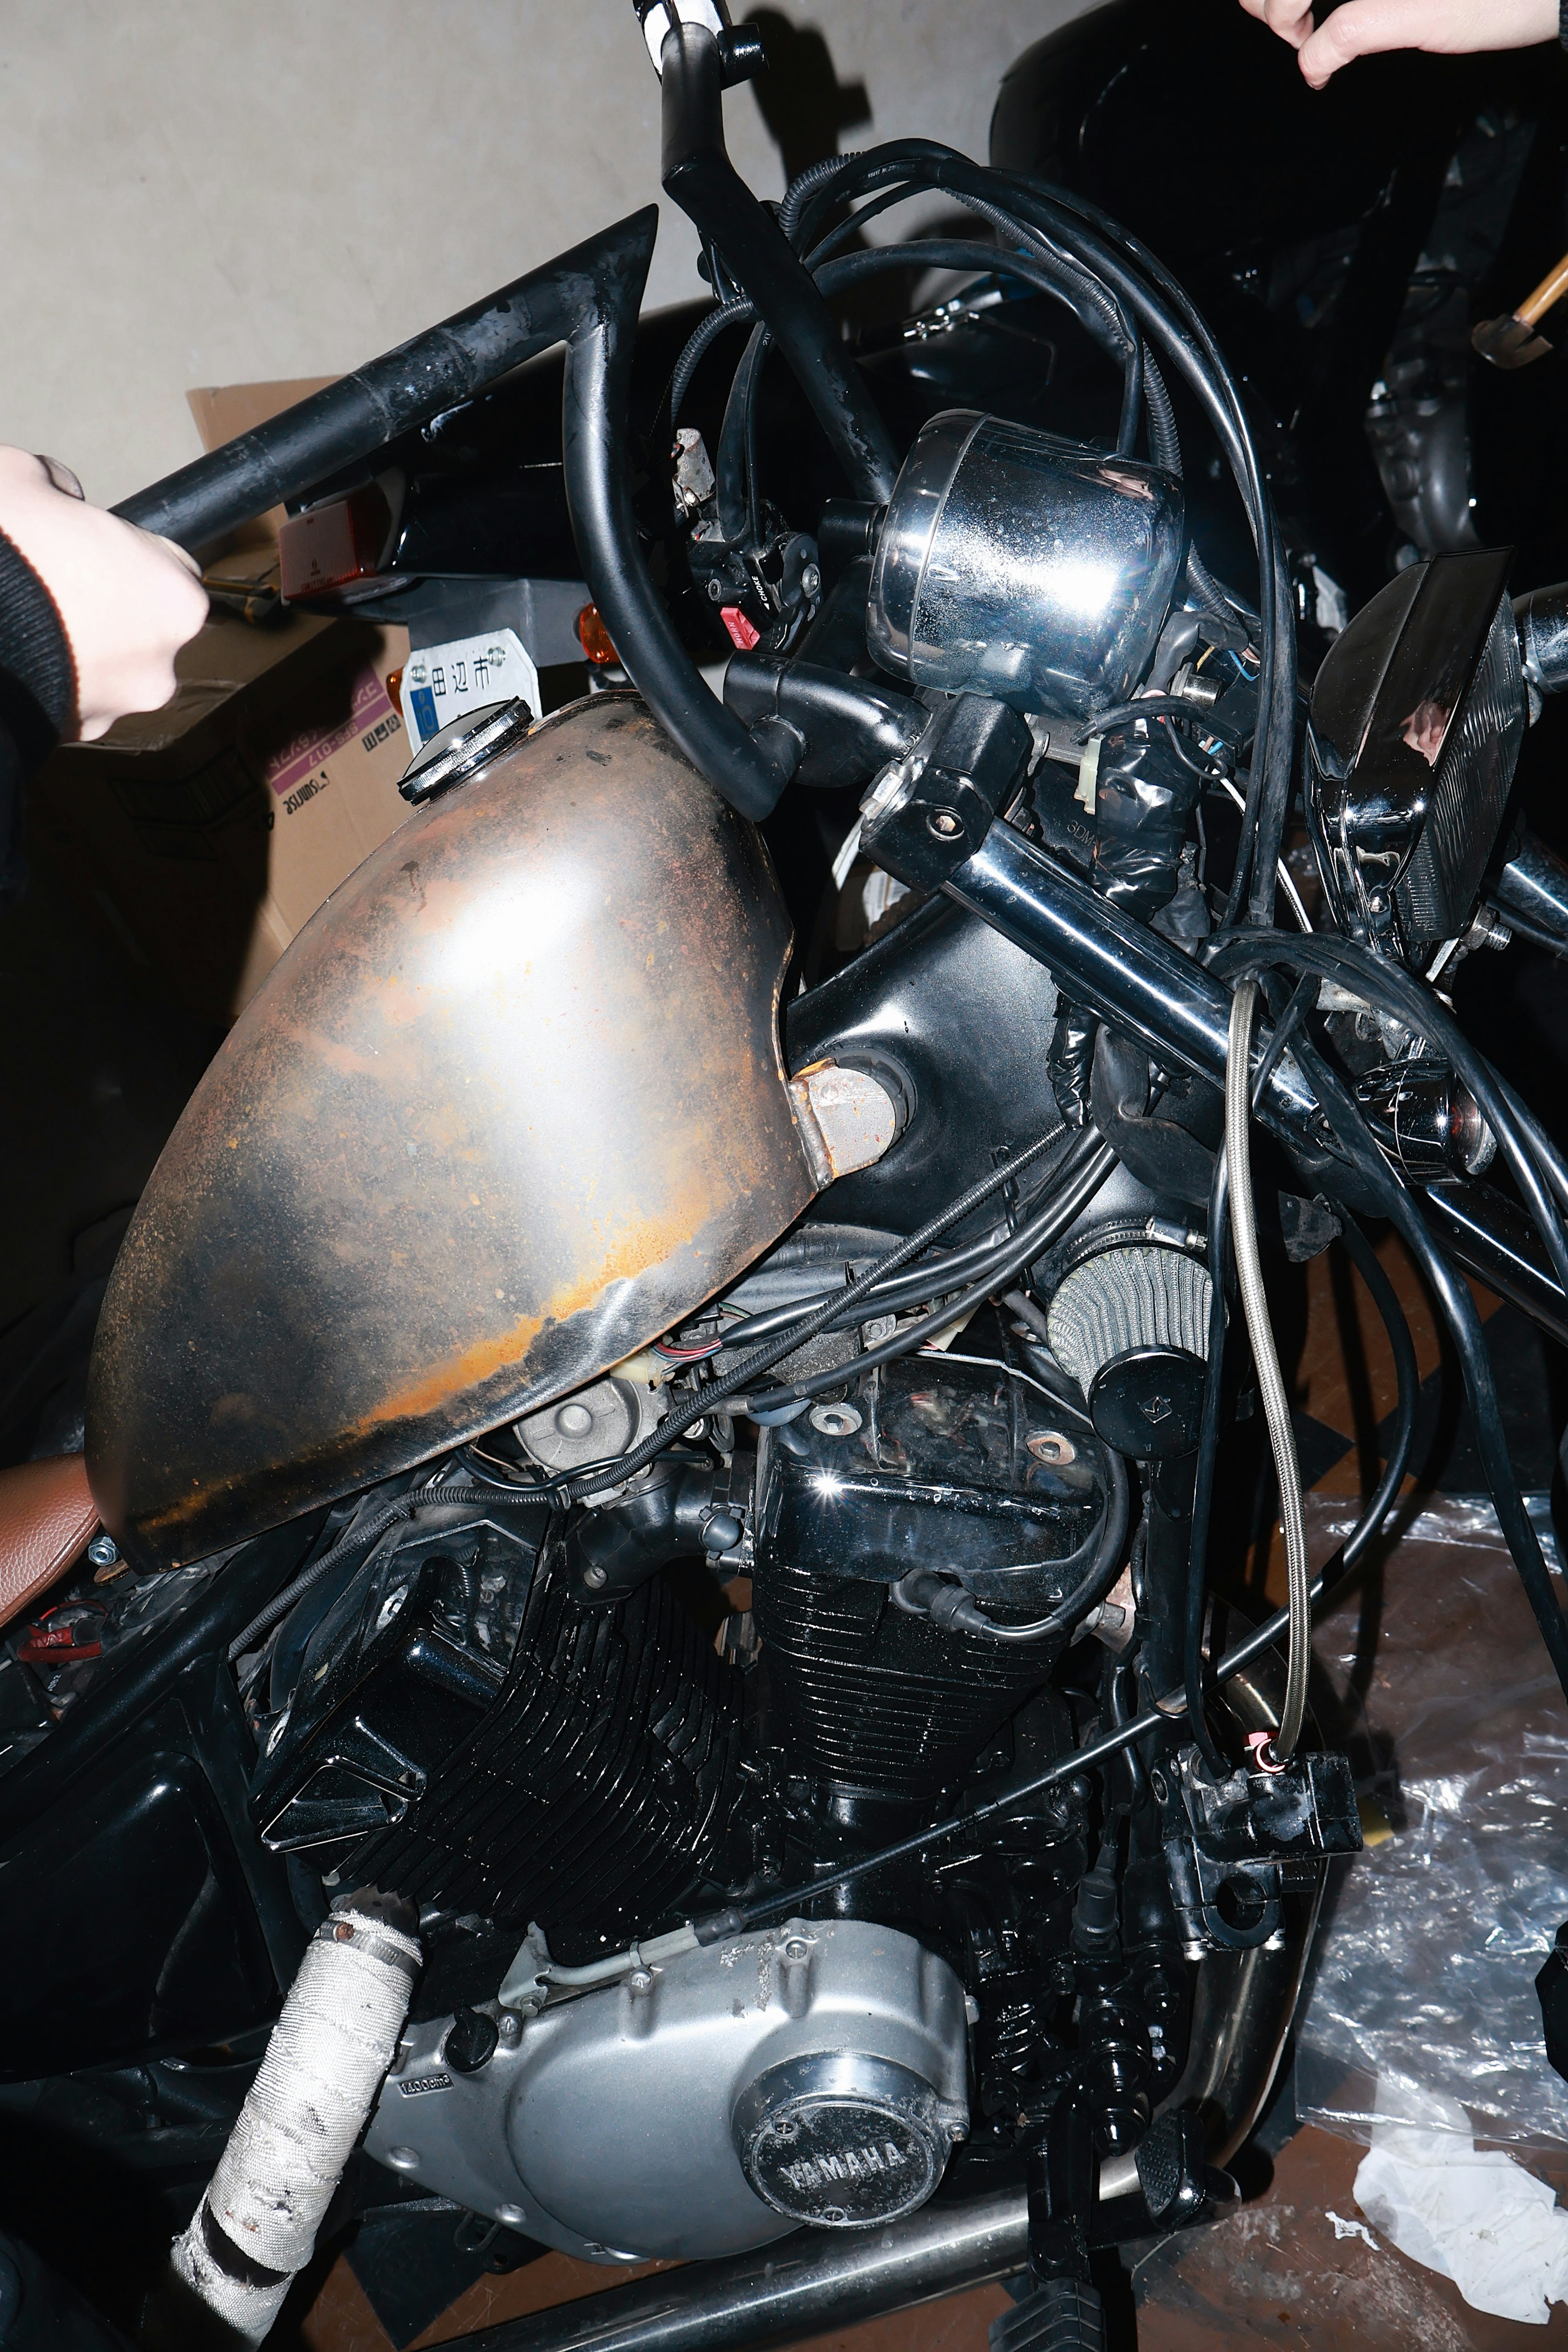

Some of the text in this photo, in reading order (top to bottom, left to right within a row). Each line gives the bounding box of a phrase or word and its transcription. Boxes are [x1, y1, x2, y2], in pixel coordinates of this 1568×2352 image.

[751, 576, 768, 601] CHOKE
[728, 622, 743, 644] HORN
[432, 655, 490, 697] 田辺市
[308, 722, 359, 767] SFS-017
[780, 2142, 906, 2188] YAMAHA
